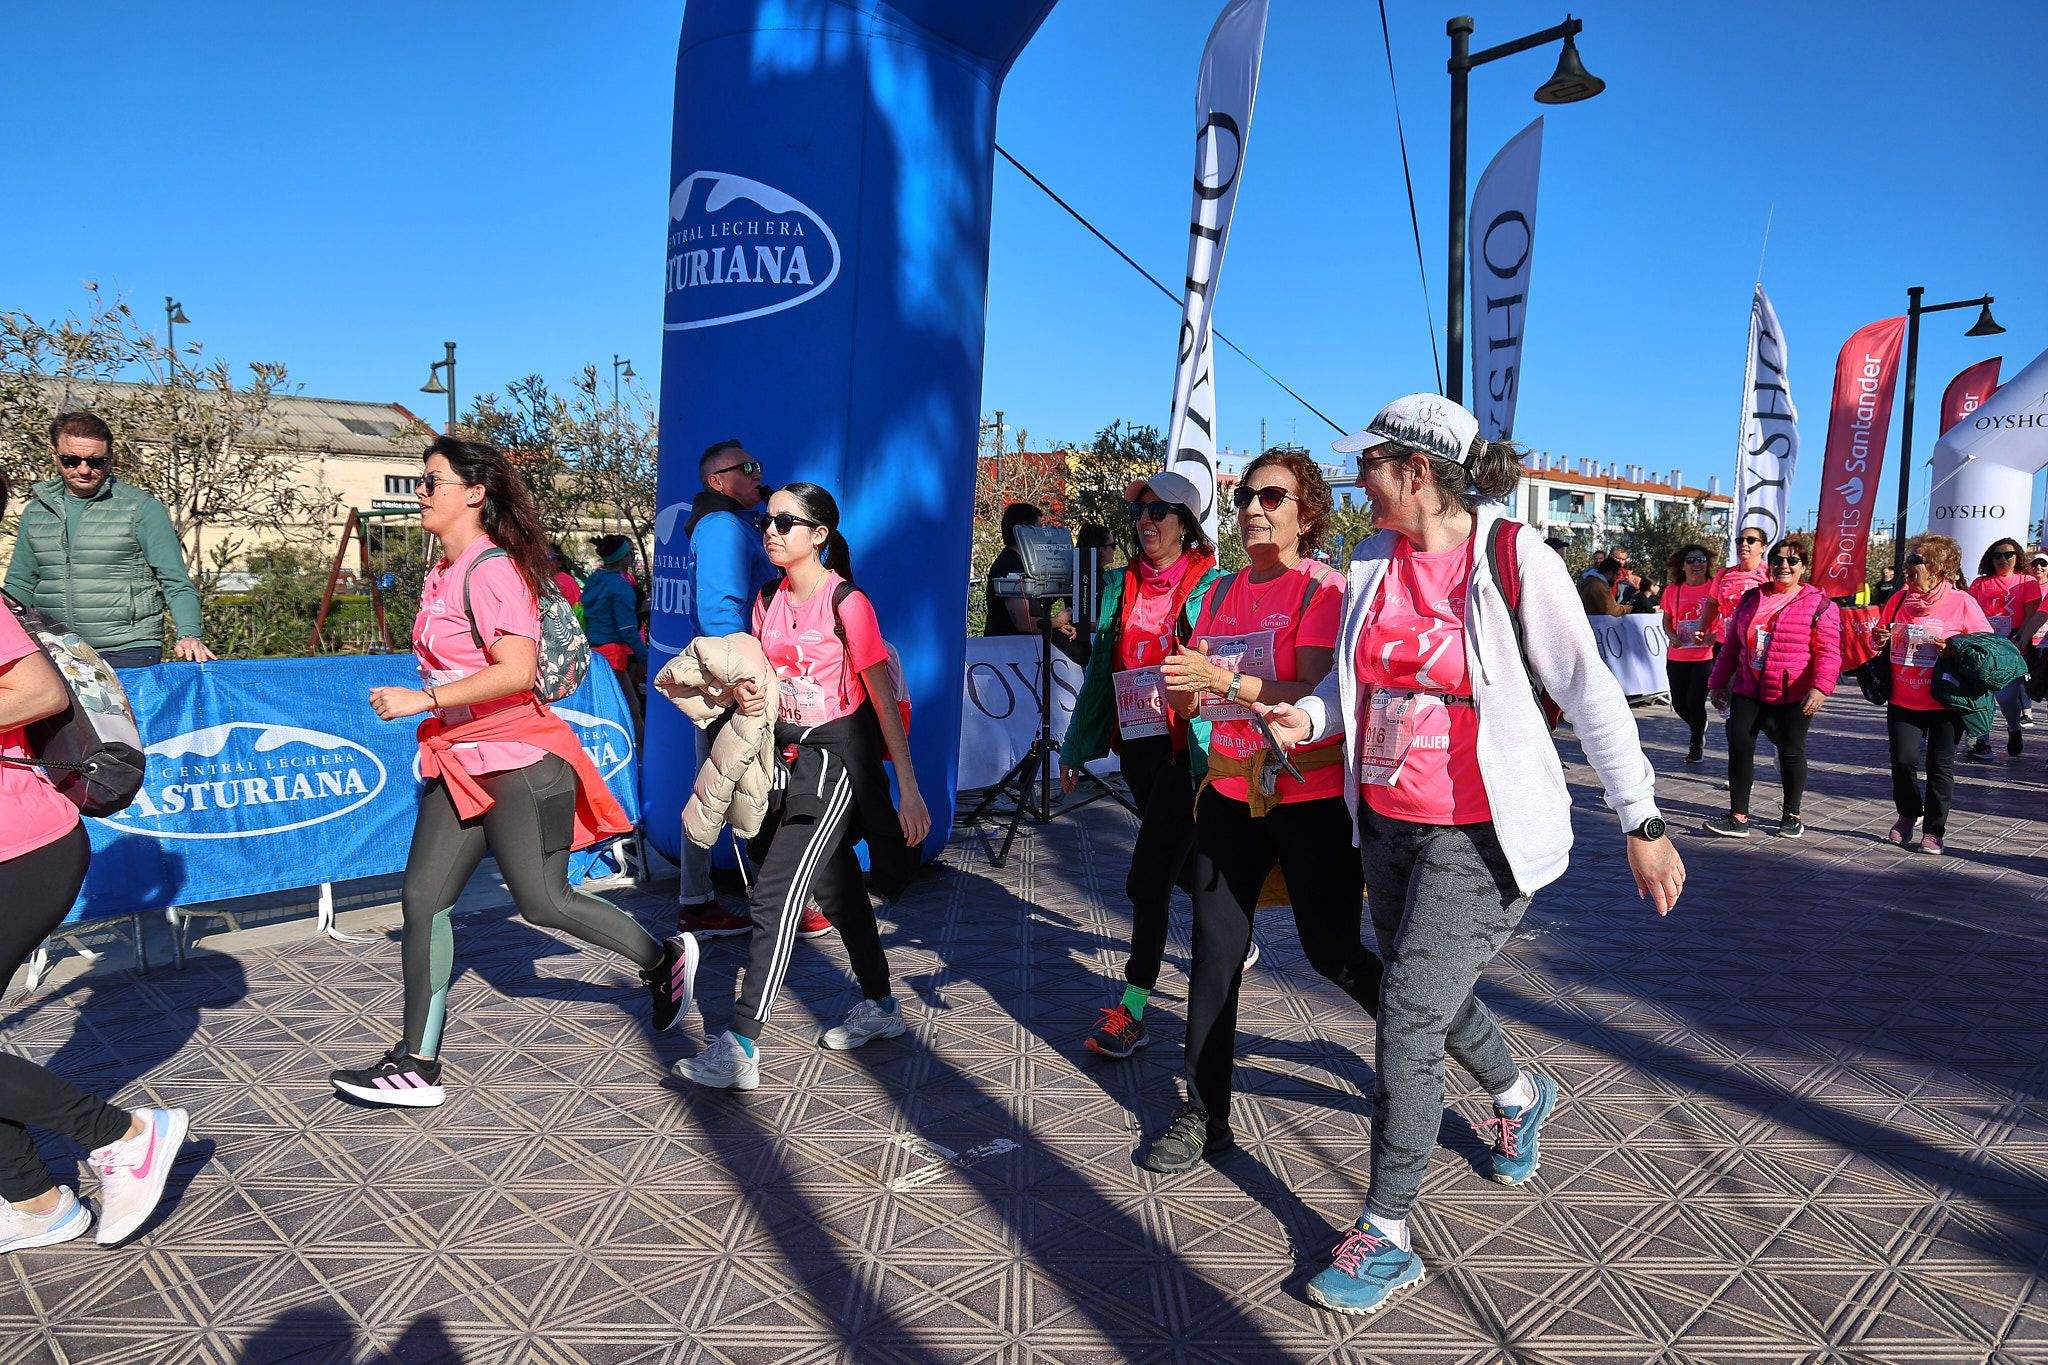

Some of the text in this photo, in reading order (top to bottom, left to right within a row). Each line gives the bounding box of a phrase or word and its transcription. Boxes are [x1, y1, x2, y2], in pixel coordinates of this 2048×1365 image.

[711, 221, 805, 237] LECHERA
[665, 244, 814, 294] TURIANA
[1829, 353, 1882, 580] Sports Santander
[1935, 504, 2006, 520] OYSHO
[1411, 734, 1450, 749] MUJER
[162, 751, 356, 780] CENTRAL LECHERA
[114, 767, 370, 820] ASTURIANA
